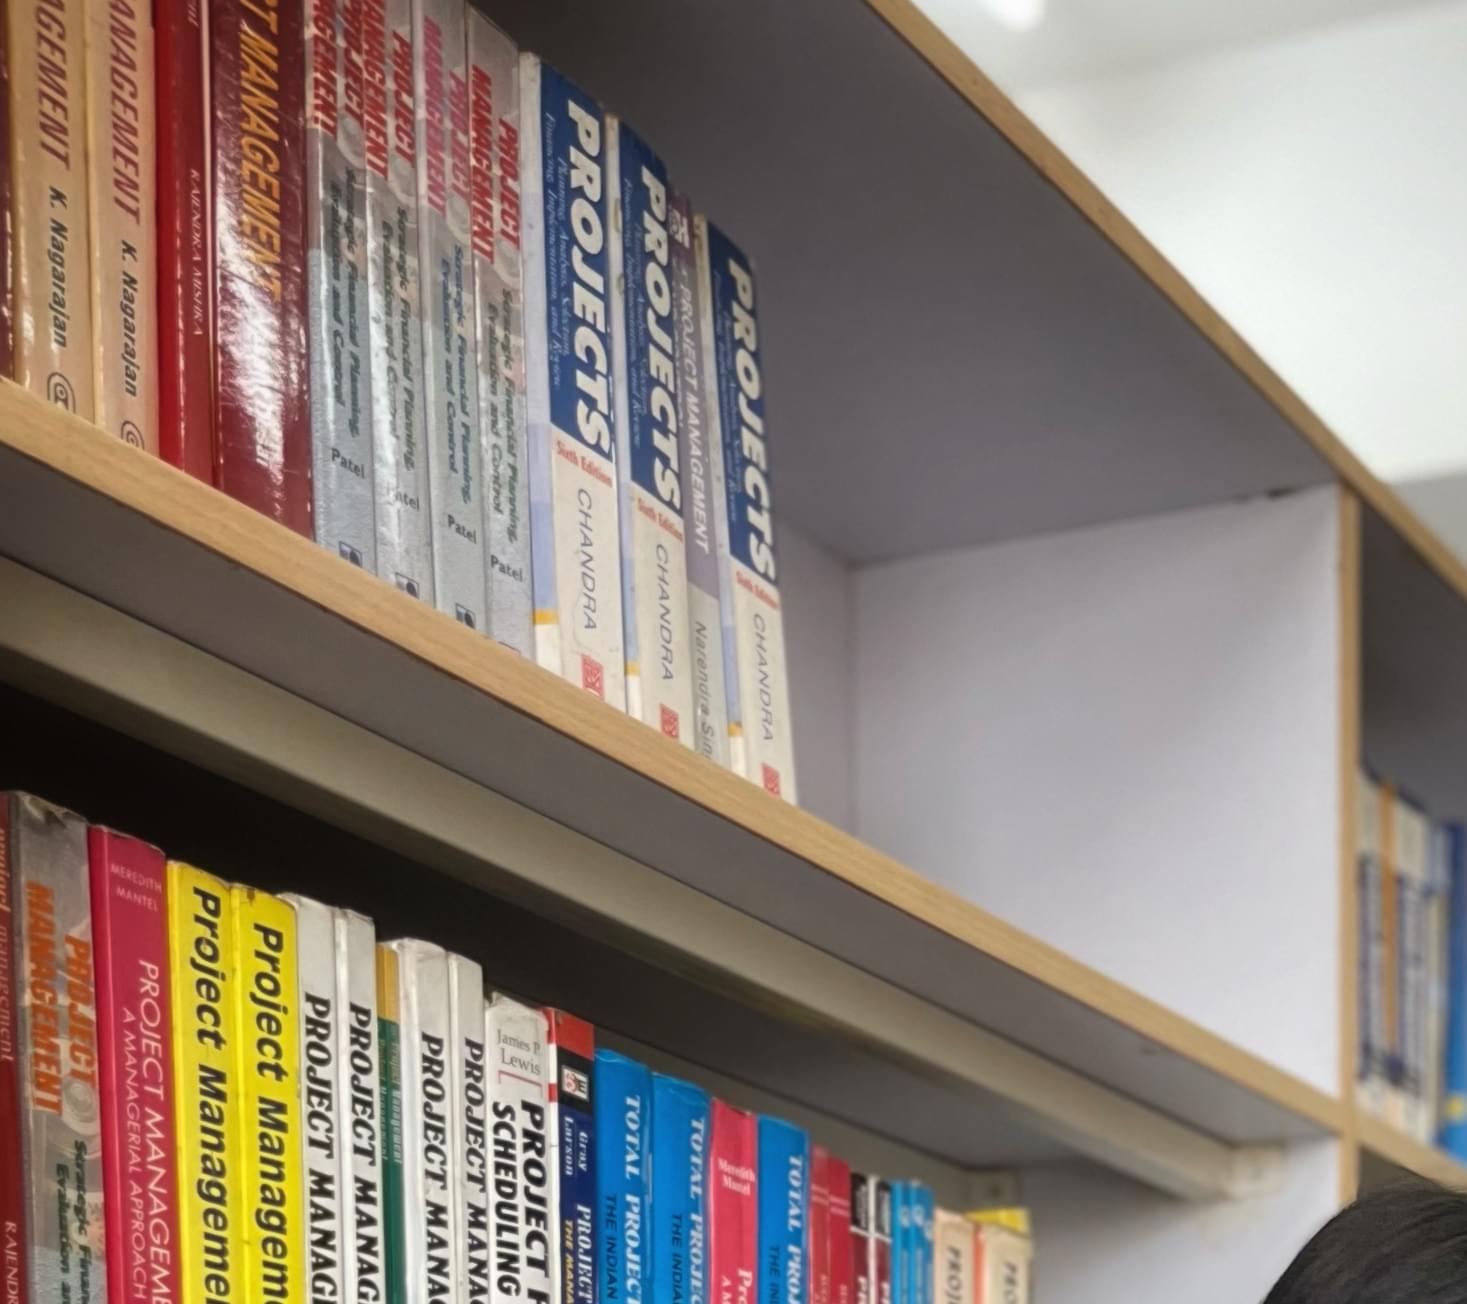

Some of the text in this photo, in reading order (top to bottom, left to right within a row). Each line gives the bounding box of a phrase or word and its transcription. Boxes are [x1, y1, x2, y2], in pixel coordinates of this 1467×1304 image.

[47, 224, 70, 348] Nagarajan
[120, 275, 139, 398] Nagarajan
[568, 99, 614, 464] PROJECTS
[640, 165, 683, 516] PROJECTS
[331, 448, 366, 479] Patel
[556, 440, 613, 488] Sixth Edition
[681, 282, 709, 554] PROJECT MANAGEMENT
[729, 257, 776, 586] PROJECTS
[447, 514, 477, 544] Patel
[490, 554, 524, 583] Patel
[577, 486, 598, 631] CHANDRA
[655, 543, 673, 681] CHANDRA
[752, 613, 773, 741] CHANDRA
[110, 864, 162, 893] MEREDITH
[26, 880, 61, 1115] MANAGEMENT
[65, 934, 96, 1087] PROJECT
[138, 959, 164, 1102] PROJECT
[190, 886, 228, 1050] Project
[249, 922, 289, 1082] Project
[305, 992, 334, 1160] PROJECT
[350, 1001, 376, 1167] PROJECT
[421, 1031, 447, 1190] PROJECT
[497, 1029, 531, 1053] James
[501, 1048, 541, 1075] Lewis
[122, 1007, 147, 1299] A MANAGERIAL APPROACH
[464, 1036, 486, 1193] PROJECT
[565, 1116, 575, 1176] Larson
[577, 1131, 588, 1173] Gray
[625, 1096, 641, 1179] TOTAL
[492, 1101, 521, 1297] SCHEDULING
[520, 1100, 549, 1277] PROJECT
[577, 1204, 593, 1304] PROJECT
[604, 1195, 617, 1225] THE
[604, 1238, 617, 1299] INDIAN
